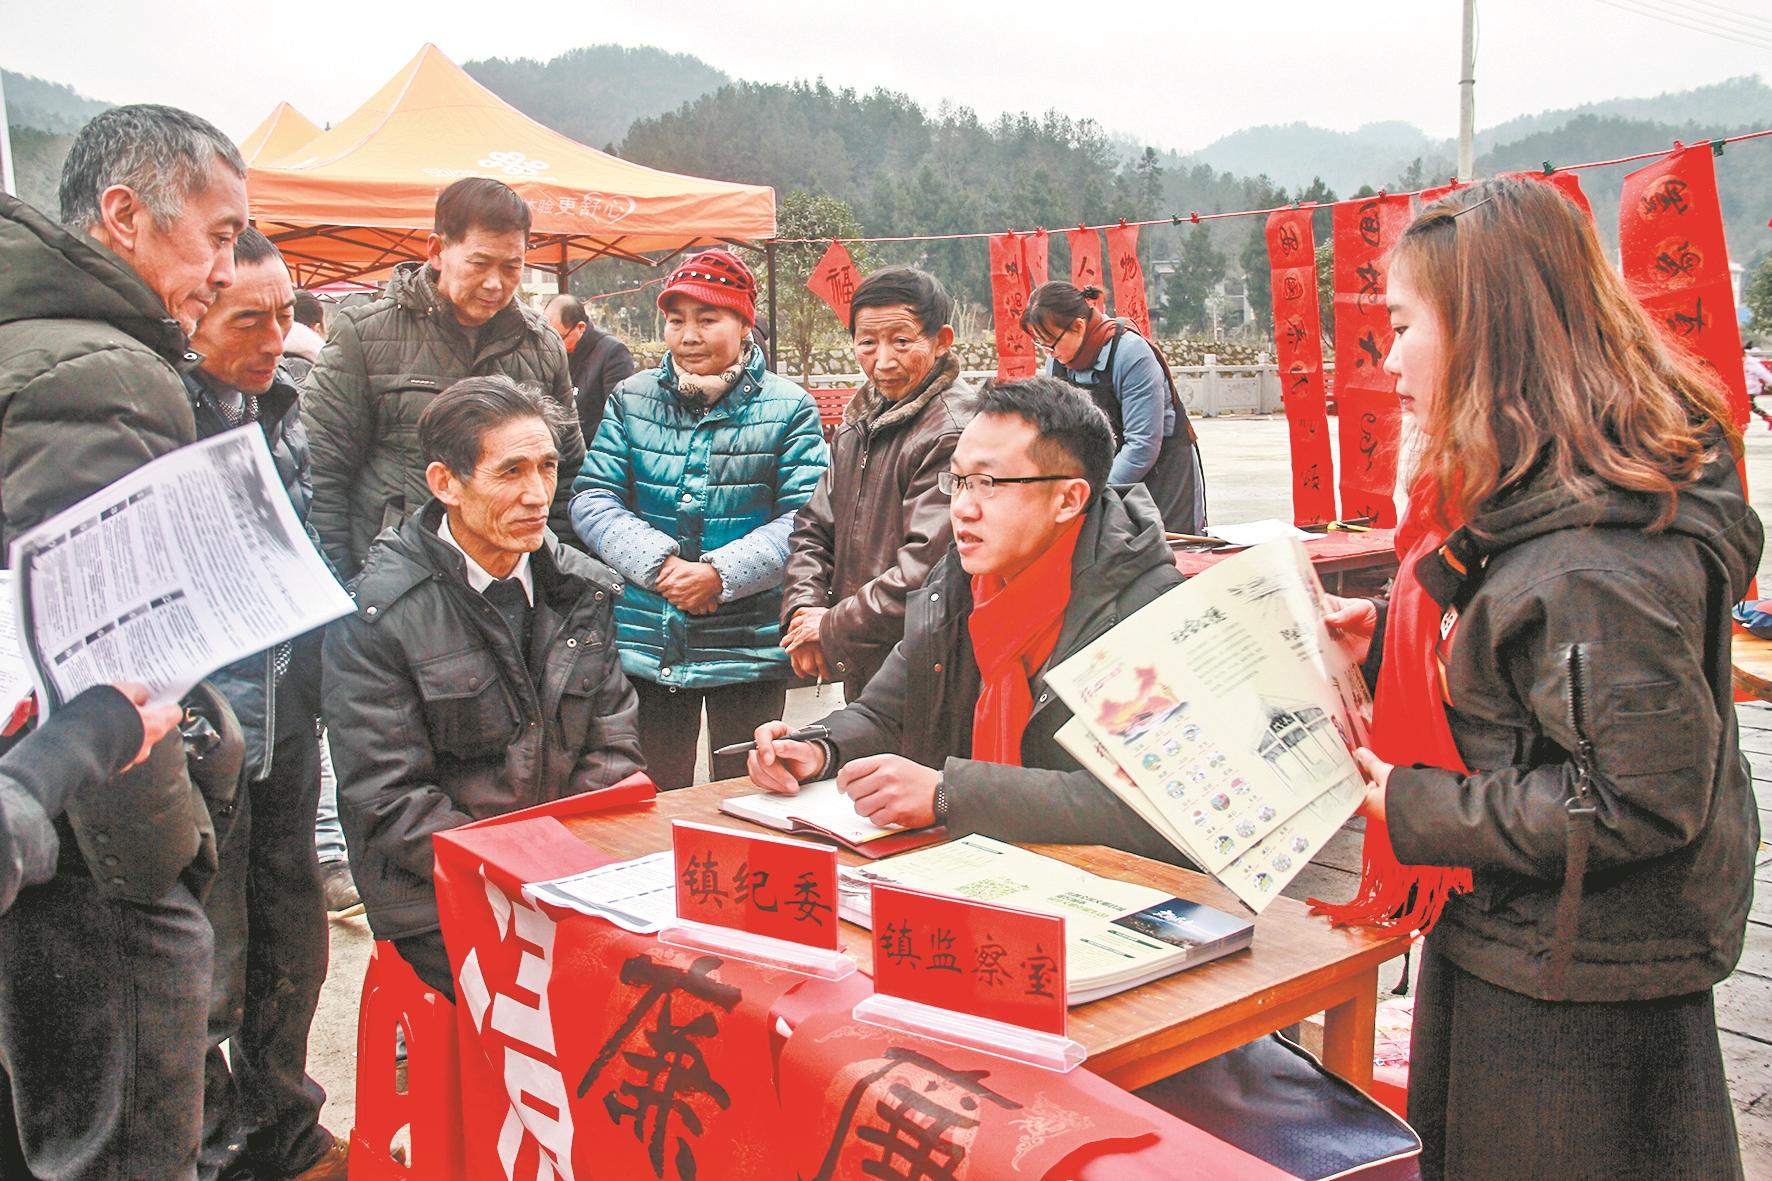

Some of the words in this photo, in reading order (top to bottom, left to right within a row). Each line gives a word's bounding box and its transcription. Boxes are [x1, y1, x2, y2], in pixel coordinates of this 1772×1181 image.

[826, 265, 855, 305] 福
[682, 850, 832, 927] 镇纪委
[880, 919, 1057, 998] 镇监察室
